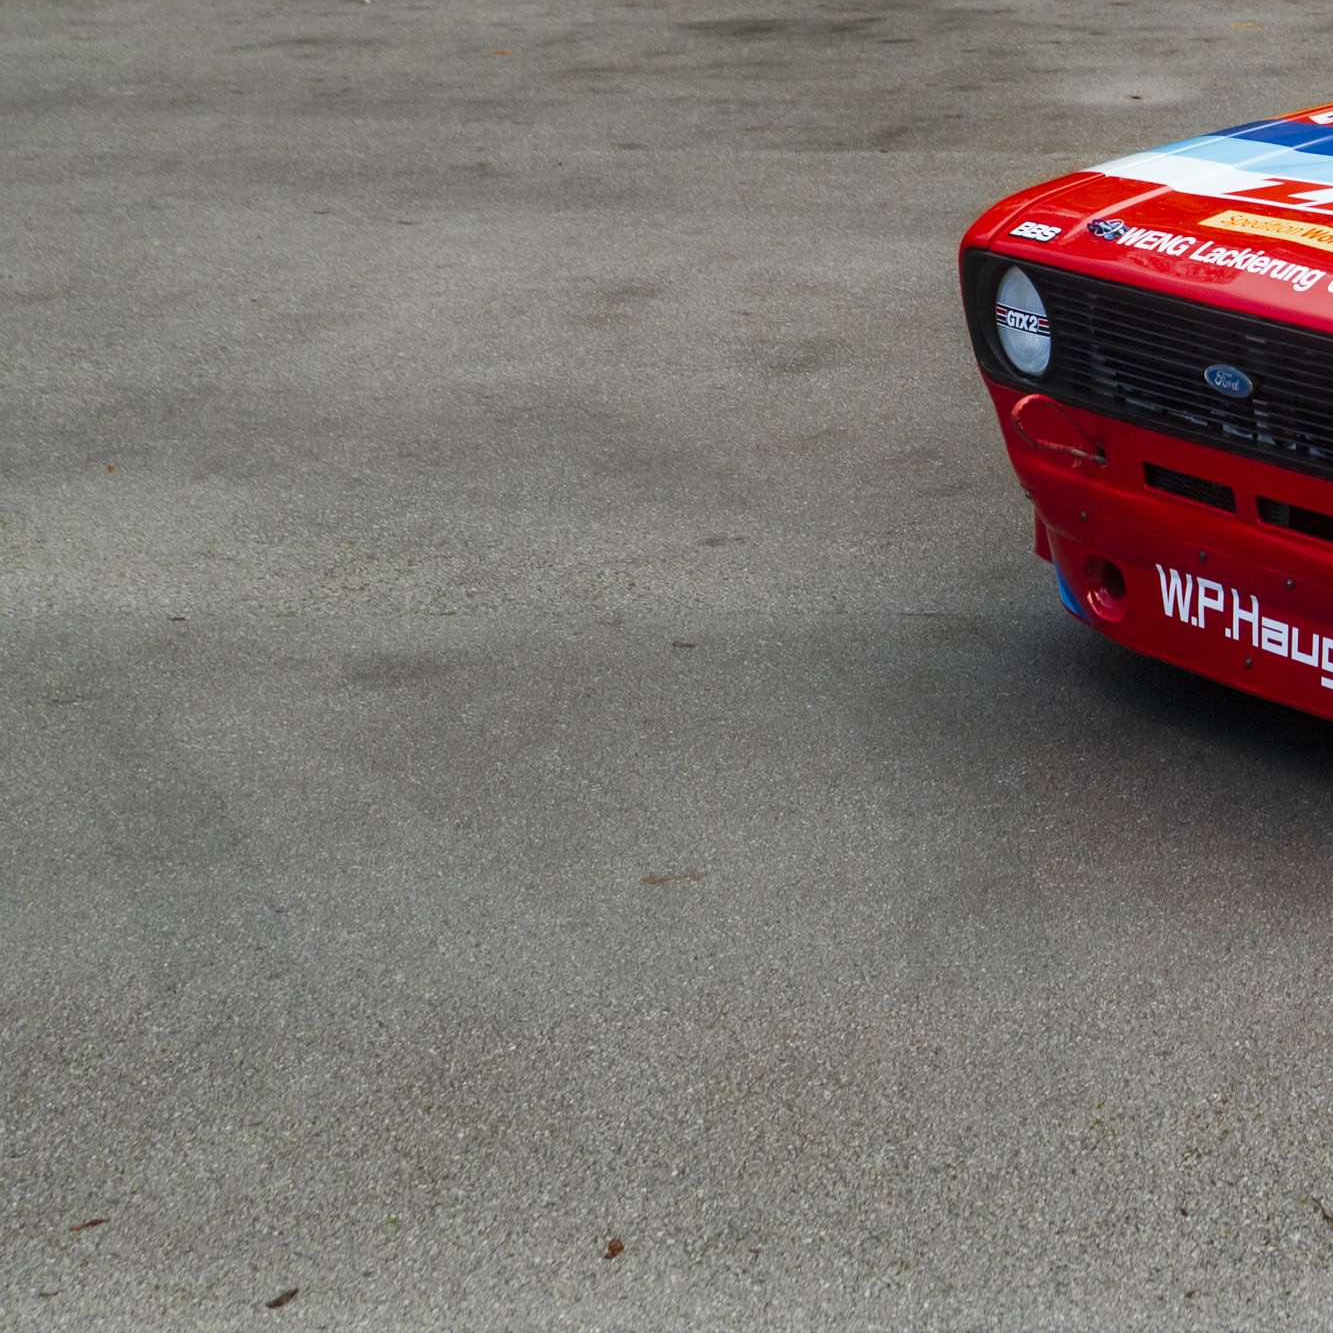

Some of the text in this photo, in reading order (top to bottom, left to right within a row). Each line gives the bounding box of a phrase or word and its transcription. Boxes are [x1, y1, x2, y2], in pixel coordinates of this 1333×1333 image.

[1009, 221, 1062, 243] BBS
[1220, 213, 1305, 240] Spedition
[1116, 226, 1197, 257] WENG
[1188, 240, 1327, 292] Lackierung
[1214, 369, 1241, 393] Ford
